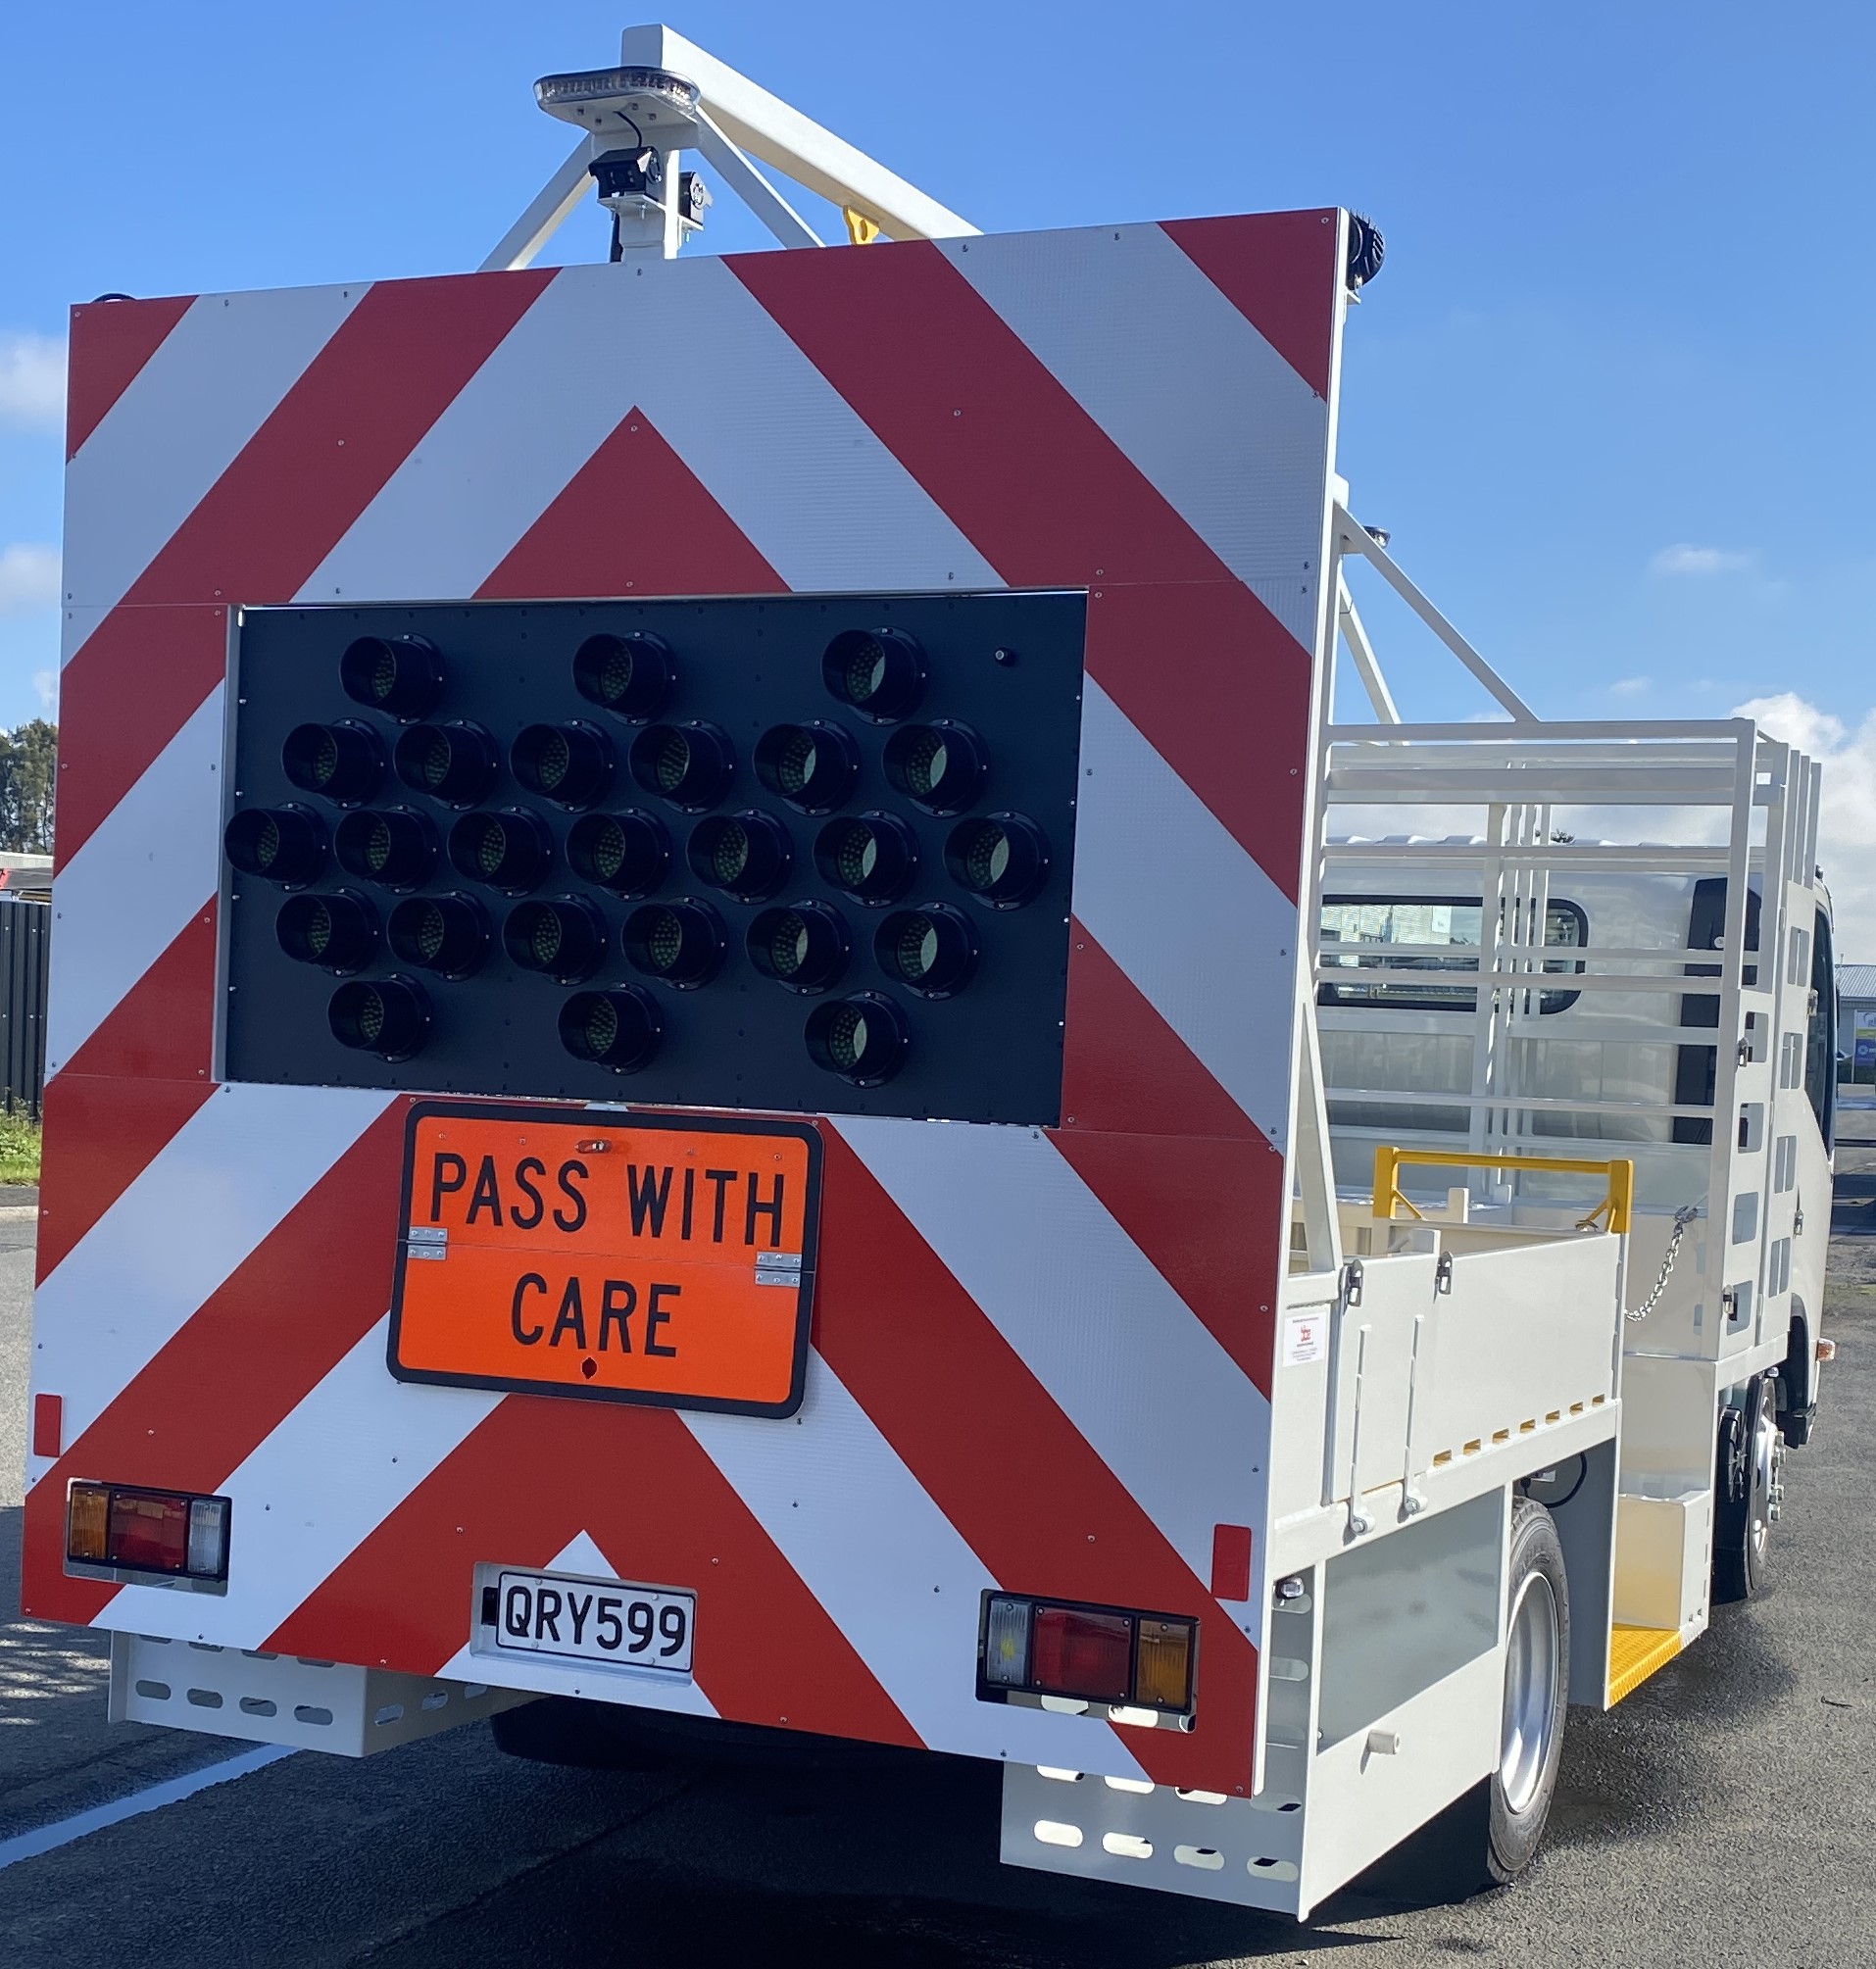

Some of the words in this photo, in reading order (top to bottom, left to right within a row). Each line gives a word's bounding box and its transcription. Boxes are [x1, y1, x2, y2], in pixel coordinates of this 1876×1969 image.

[430, 1153, 589, 1232] PASS
[627, 1164, 784, 1248] WITH
[511, 1272, 681, 1357] CARE
[505, 1585, 686, 1656] QRY599
